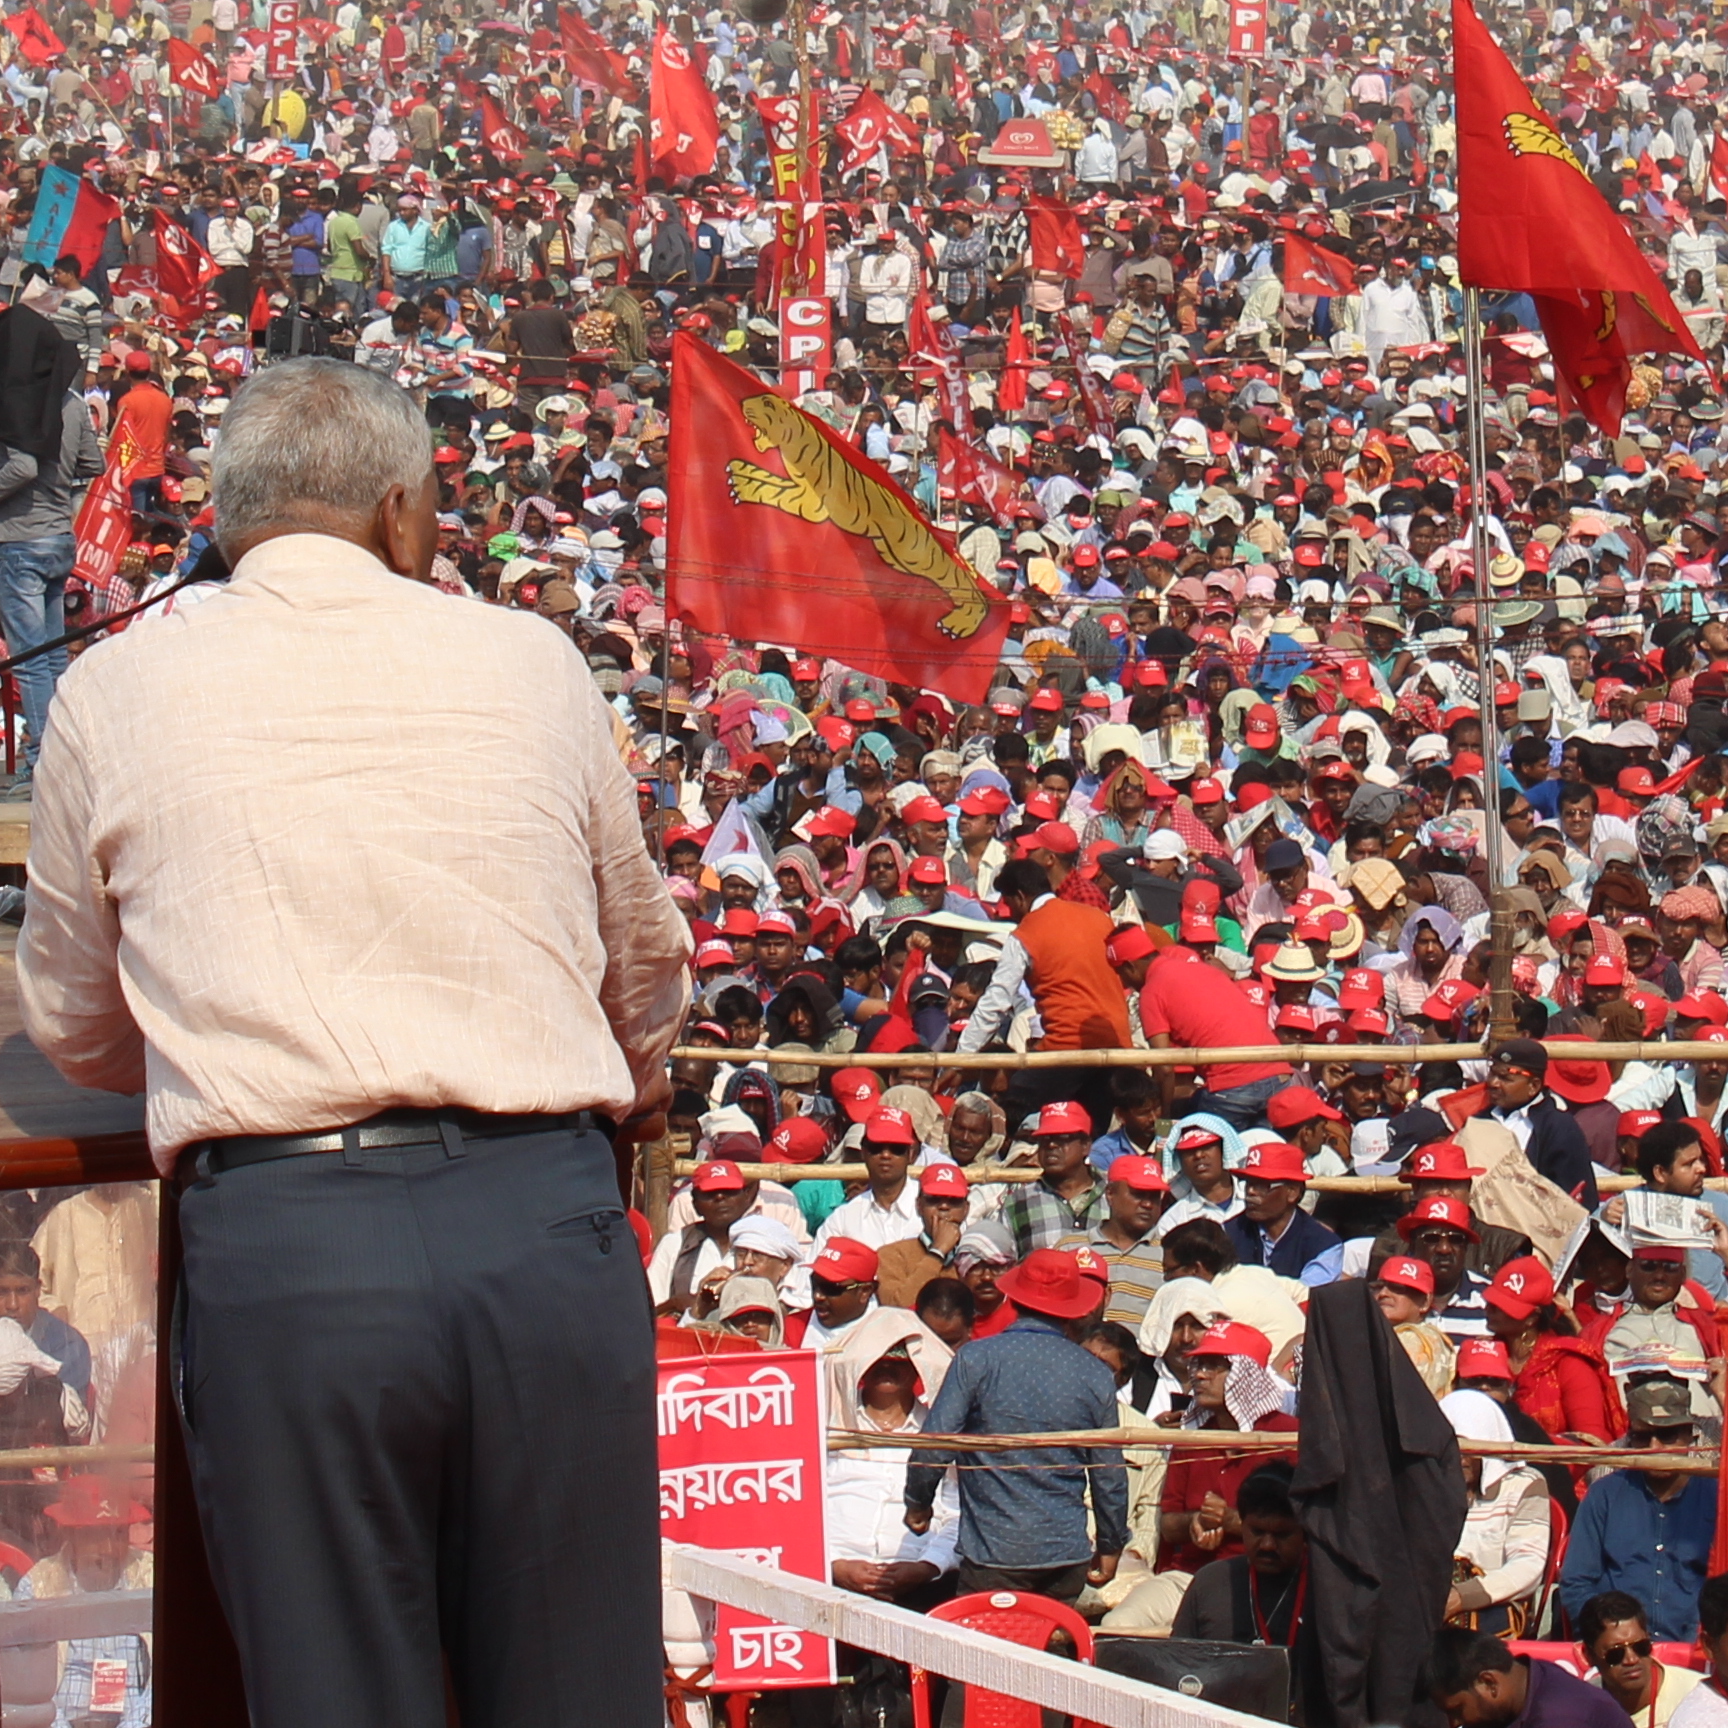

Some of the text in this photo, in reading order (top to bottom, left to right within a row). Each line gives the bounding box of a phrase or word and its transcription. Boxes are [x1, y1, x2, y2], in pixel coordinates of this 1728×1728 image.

[271, 5, 296, 72] CPI
[657, 1366, 795, 1437] দিবাসী
[660, 1459, 804, 1520] ন্নয়নের
